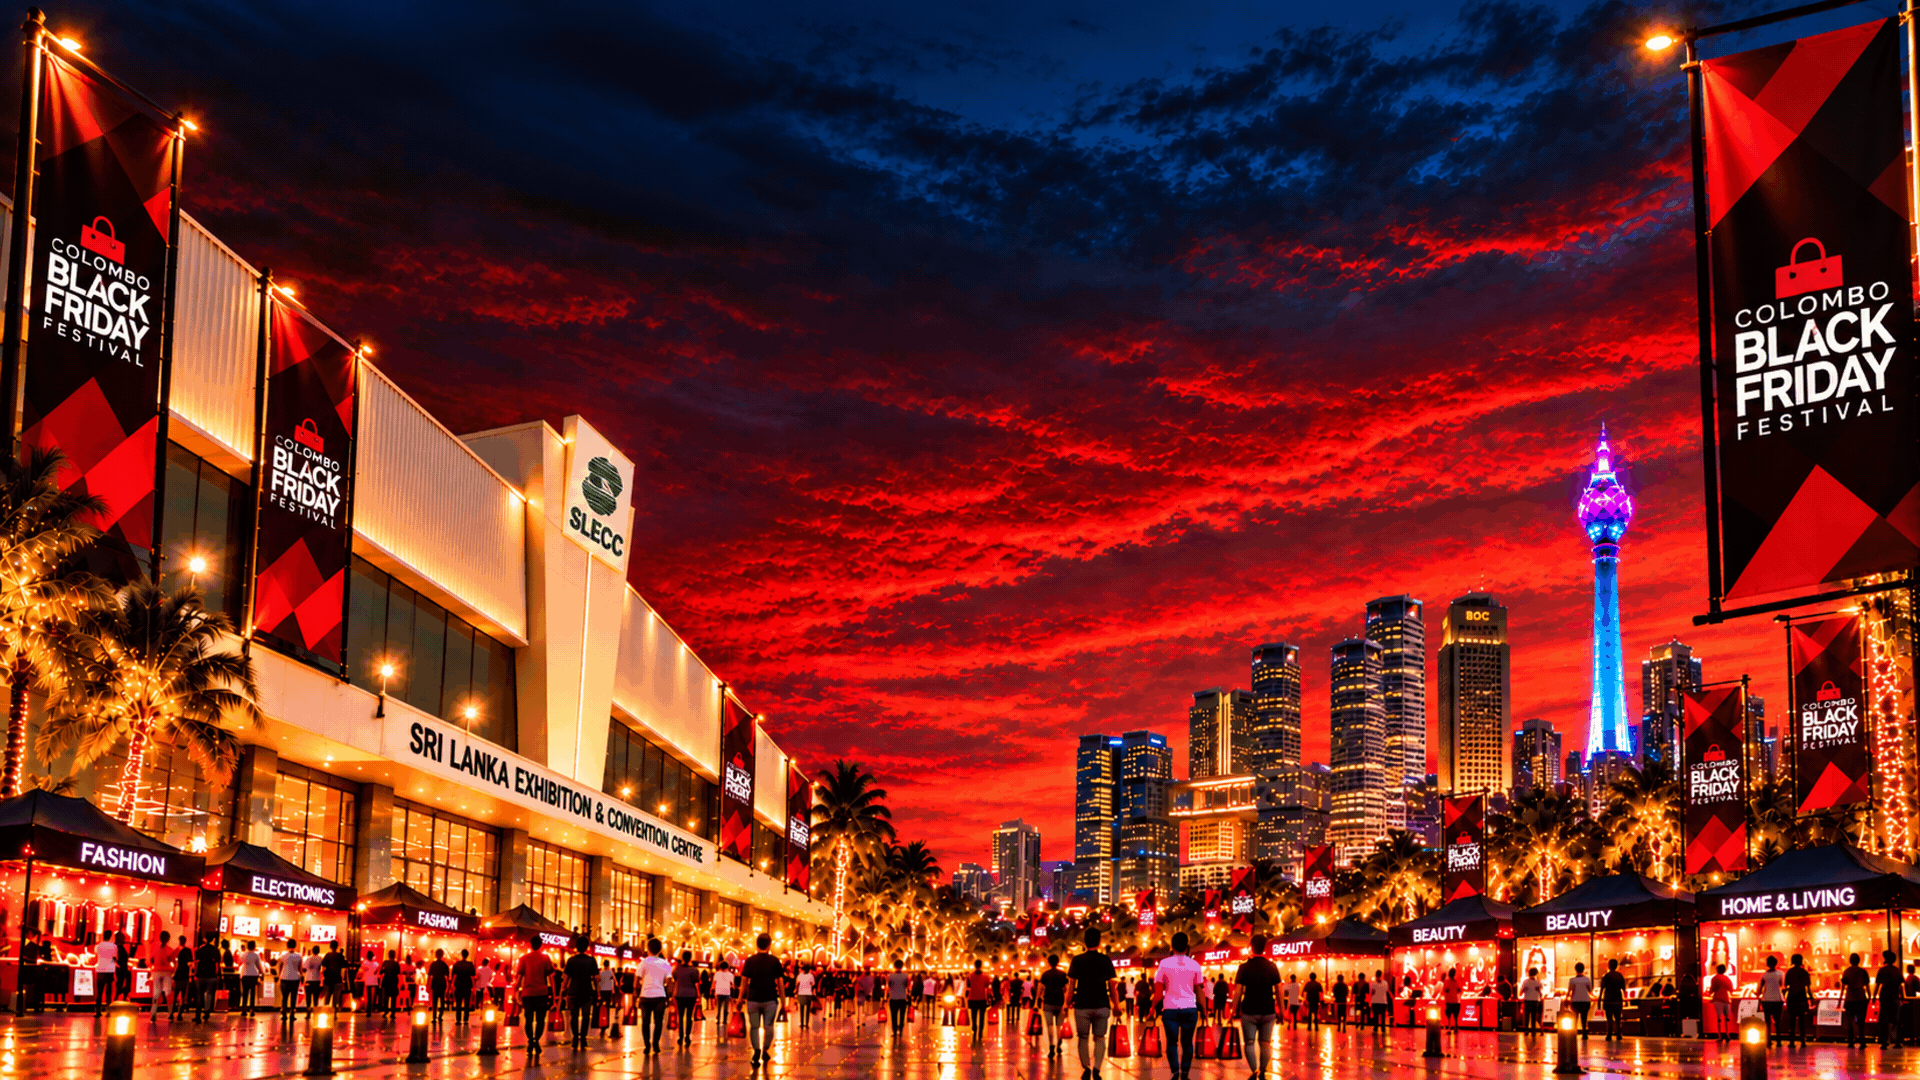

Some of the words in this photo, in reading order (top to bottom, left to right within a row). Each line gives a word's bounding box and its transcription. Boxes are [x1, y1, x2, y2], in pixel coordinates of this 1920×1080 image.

[52, 238, 150, 291] COLOMBO
[47, 251, 151, 325] BLACK
[1735, 281, 1889, 328] COLOMBO
[45, 283, 150, 350] FRIDAY
[44, 316, 144, 368] FESTIVAL
[1735, 302, 1897, 374] BLACK
[1736, 346, 1897, 417] FRIDAY
[1737, 395, 1893, 441] FESTIVAL
[273, 445, 341, 497] BLACK
[275, 435, 340, 472] COLOMBO
[270, 493, 336, 530] FESTIVAL
[271, 469, 341, 517] FRIDAY
[569, 506, 624, 557] SLECC
[1465, 610, 1490, 621] BOC
[1802, 704, 1859, 726] BLACK
[1803, 720, 1859, 742] FRIDAY
[410, 722, 443, 763] SRI
[449, 738, 510, 789] LANKA
[515, 766, 592, 820] EXHIBITION
[595, 802, 605, 824] &
[607, 807, 670, 852] CONVENTION
[670, 835, 704, 864] CENTRE
[1691, 765, 1740, 784] BLACK
[1691, 780, 1740, 798] FRIDAY
[80, 841, 166, 876] FASHION
[251, 875, 335, 905] ELECTRONICS
[1721, 895, 1773, 915] HOME
[1775, 893, 1790, 911] &
[1792, 887, 1856, 910] LIVING
[418, 911, 459, 931] FASHION
[1413, 925, 1467, 943] BEAUTY
[1546, 909, 1613, 931] BEAUTY
[1272, 940, 1314, 955] BEAUTY
